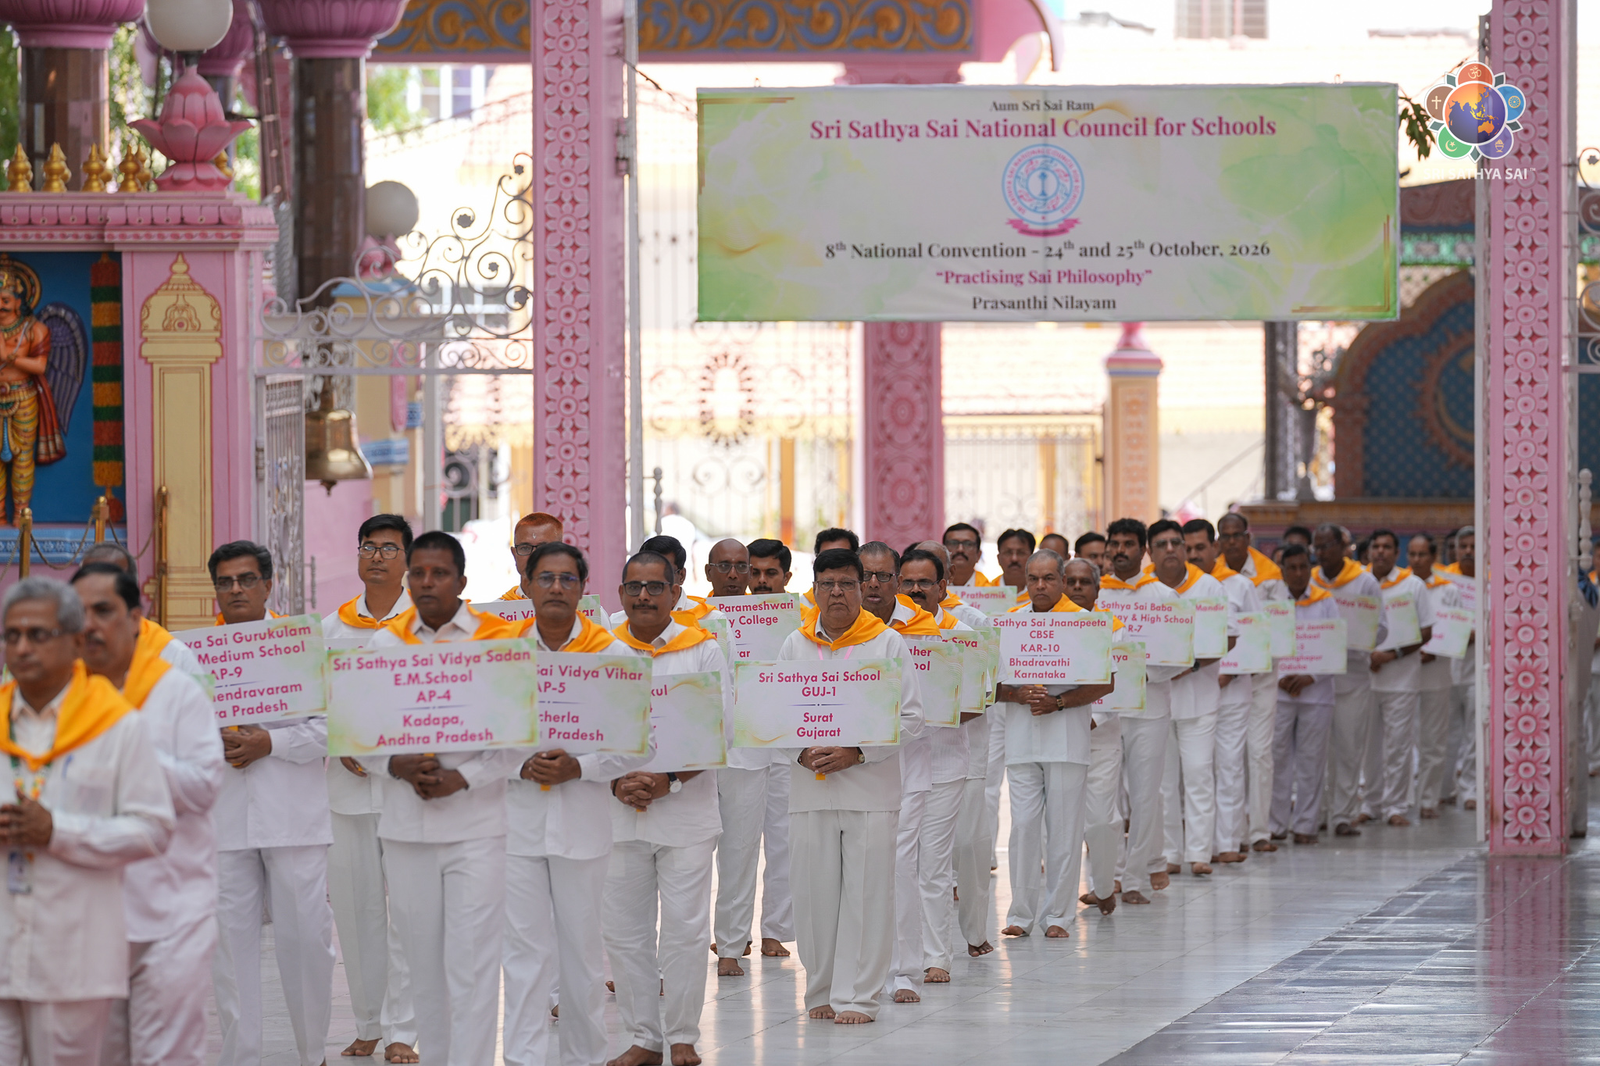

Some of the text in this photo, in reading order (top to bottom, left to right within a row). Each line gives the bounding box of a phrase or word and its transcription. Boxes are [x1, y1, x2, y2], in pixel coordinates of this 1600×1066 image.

[991, 100, 1095, 112] Aum Sri Sai Ram
[810, 116, 1277, 142] Sri Sathya Sai National Council for Schools
[826, 241, 847, 259] 8th
[851, 243, 923, 259] National
[928, 242, 1027, 259] Convention
[1044, 240, 1075, 260] 24th
[1079, 242, 1111, 258] and
[1116, 240, 1145, 260] 25th
[1150, 241, 1224, 259] October,
[1229, 242, 1271, 257] 2026
[1028, 269, 1052, 285] Sai
[972, 296, 1117, 312] Prasanthi Nilayam
[961, 590, 1007, 600] Prathamik
[719, 599, 794, 613] Parameshwari
[1101, 601, 1173, 612] Sathya Sai Baba
[739, 615, 779, 626] College
[993, 618, 1027, 629] Sathya
[1031, 618, 1046, 627] Sai
[1049, 618, 1107, 629] Jnanapeeta
[1141, 614, 1162, 624] High
[1164, 615, 1193, 624] School
[206, 633, 228, 648] Sai
[232, 625, 311, 644] Gurukulam
[1029, 630, 1054, 639] CBSE
[197, 640, 306, 666] Medium School
[1020, 644, 1060, 653] KAR-10
[333, 649, 531, 672] Sri Sathya Sai Vidya Sadan
[1009, 658, 1070, 667] Bhadravathi
[394, 670, 473, 686] E.M.School
[558, 665, 600, 681] Vidya
[605, 667, 643, 681] Vihar
[758, 670, 881, 685] Sri Sathya Sai School
[1014, 670, 1066, 679] Karnataka
[213, 683, 303, 703] endravaram
[416, 690, 452, 703] AP-4
[801, 686, 837, 698] GUJ-1
[232, 699, 288, 717] Pradesh
[402, 715, 464, 729] Kadapa,
[803, 712, 833, 723] Surat
[376, 728, 494, 747] Andhra Pradesh
[548, 727, 604, 742] Pradesh
[796, 726, 841, 740] Gujarat
